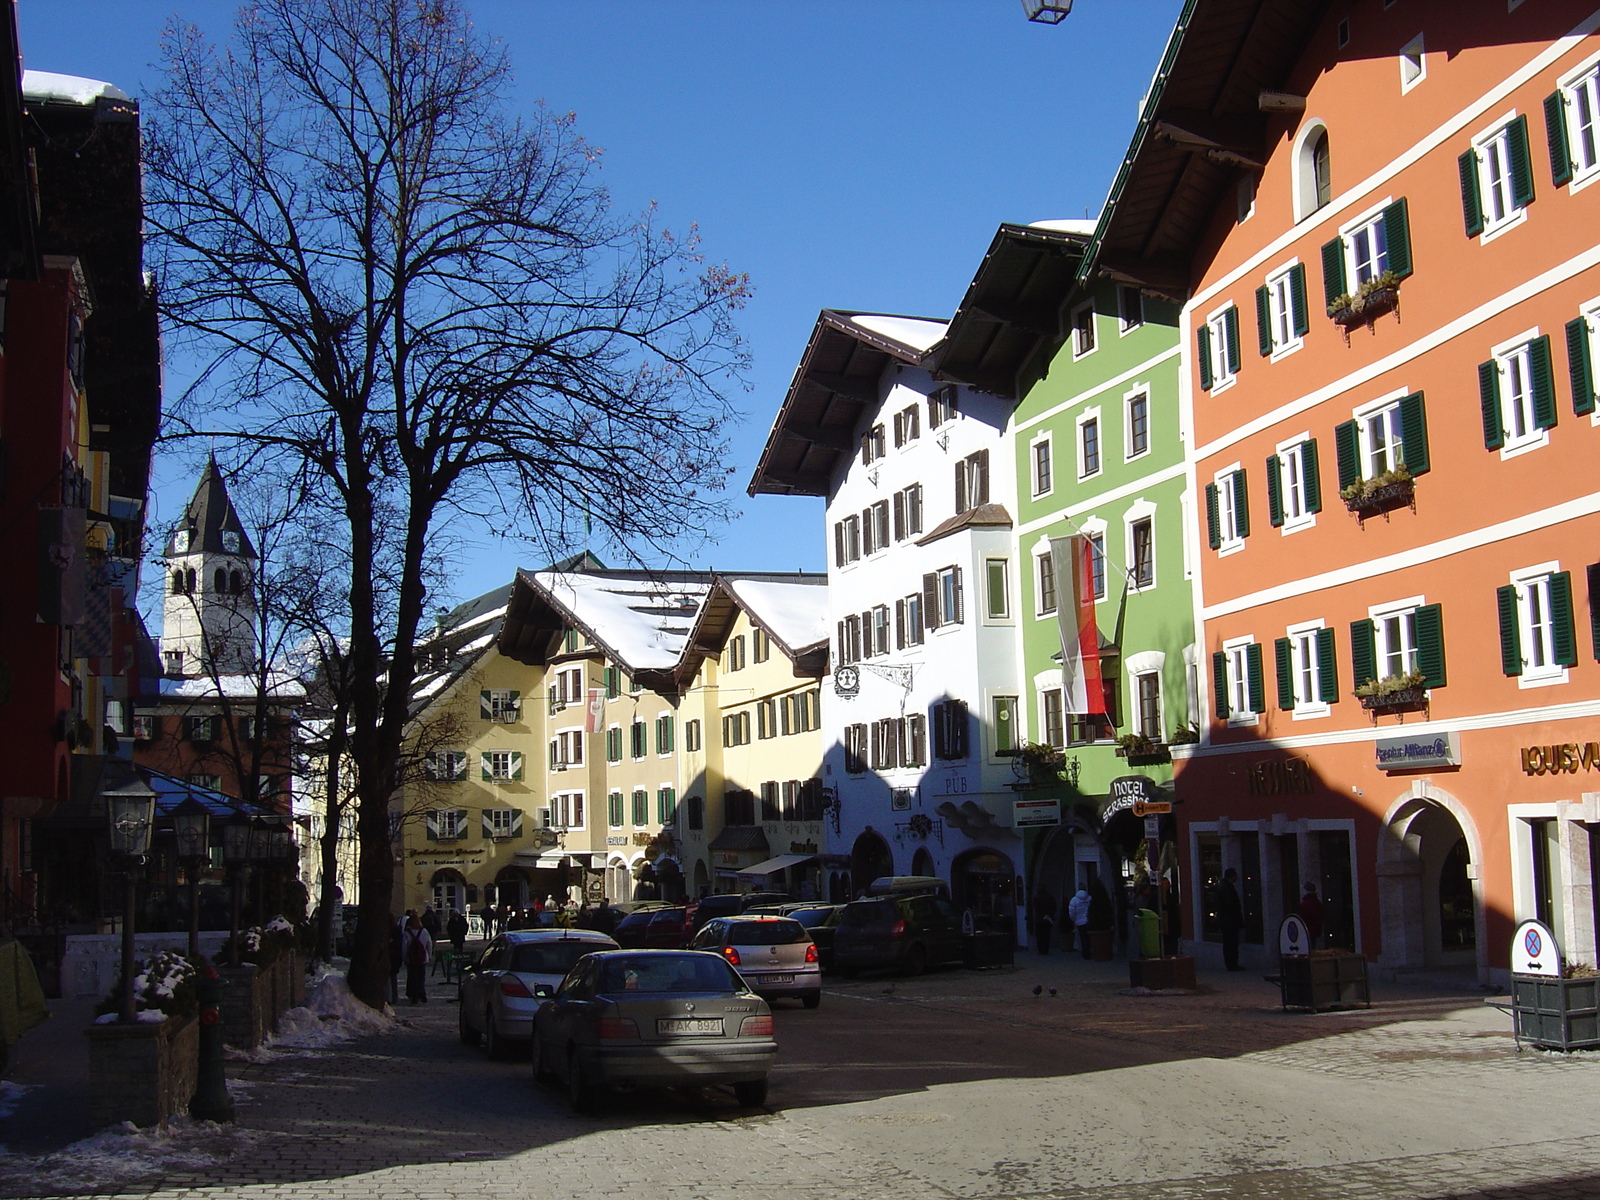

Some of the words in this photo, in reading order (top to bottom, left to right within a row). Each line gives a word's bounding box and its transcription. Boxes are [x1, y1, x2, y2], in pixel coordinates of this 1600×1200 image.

[1404, 743, 1434, 757] Allianz
[1520, 744, 1579, 774] LOUIS
[945, 777, 967, 793] PUB
[1113, 780, 1145, 797] HOTEL
[697, 1020, 720, 1031] 8921
